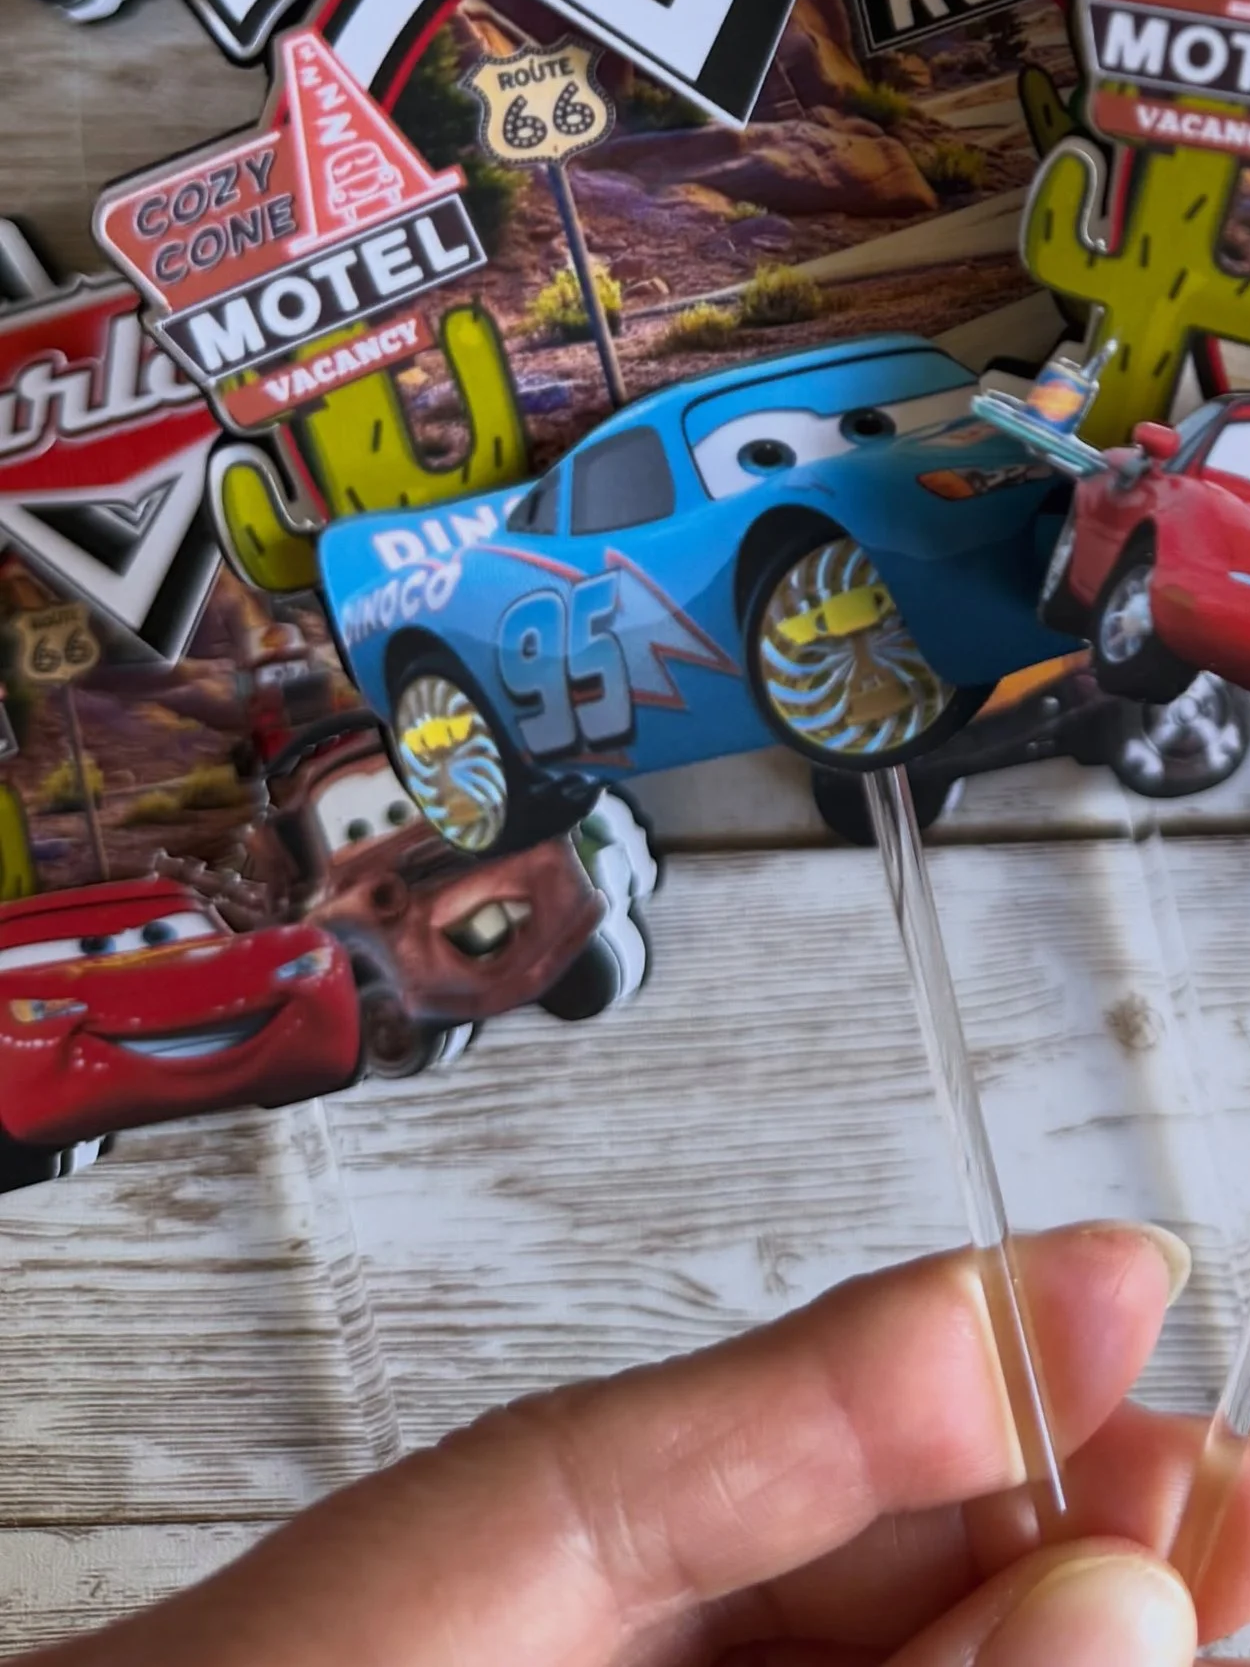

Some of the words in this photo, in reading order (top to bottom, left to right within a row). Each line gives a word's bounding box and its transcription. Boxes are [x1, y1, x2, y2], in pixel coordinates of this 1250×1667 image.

[497, 56, 575, 91] ROUTE
[502, 80, 596, 150] 66
[135, 147, 277, 240] COZY
[153, 191, 299, 284] CONE
[186, 214, 471, 375] MOTEL
[262, 318, 419, 404] VACANCY
[33, 630, 96, 674] 66
[500, 568, 635, 756] 95
